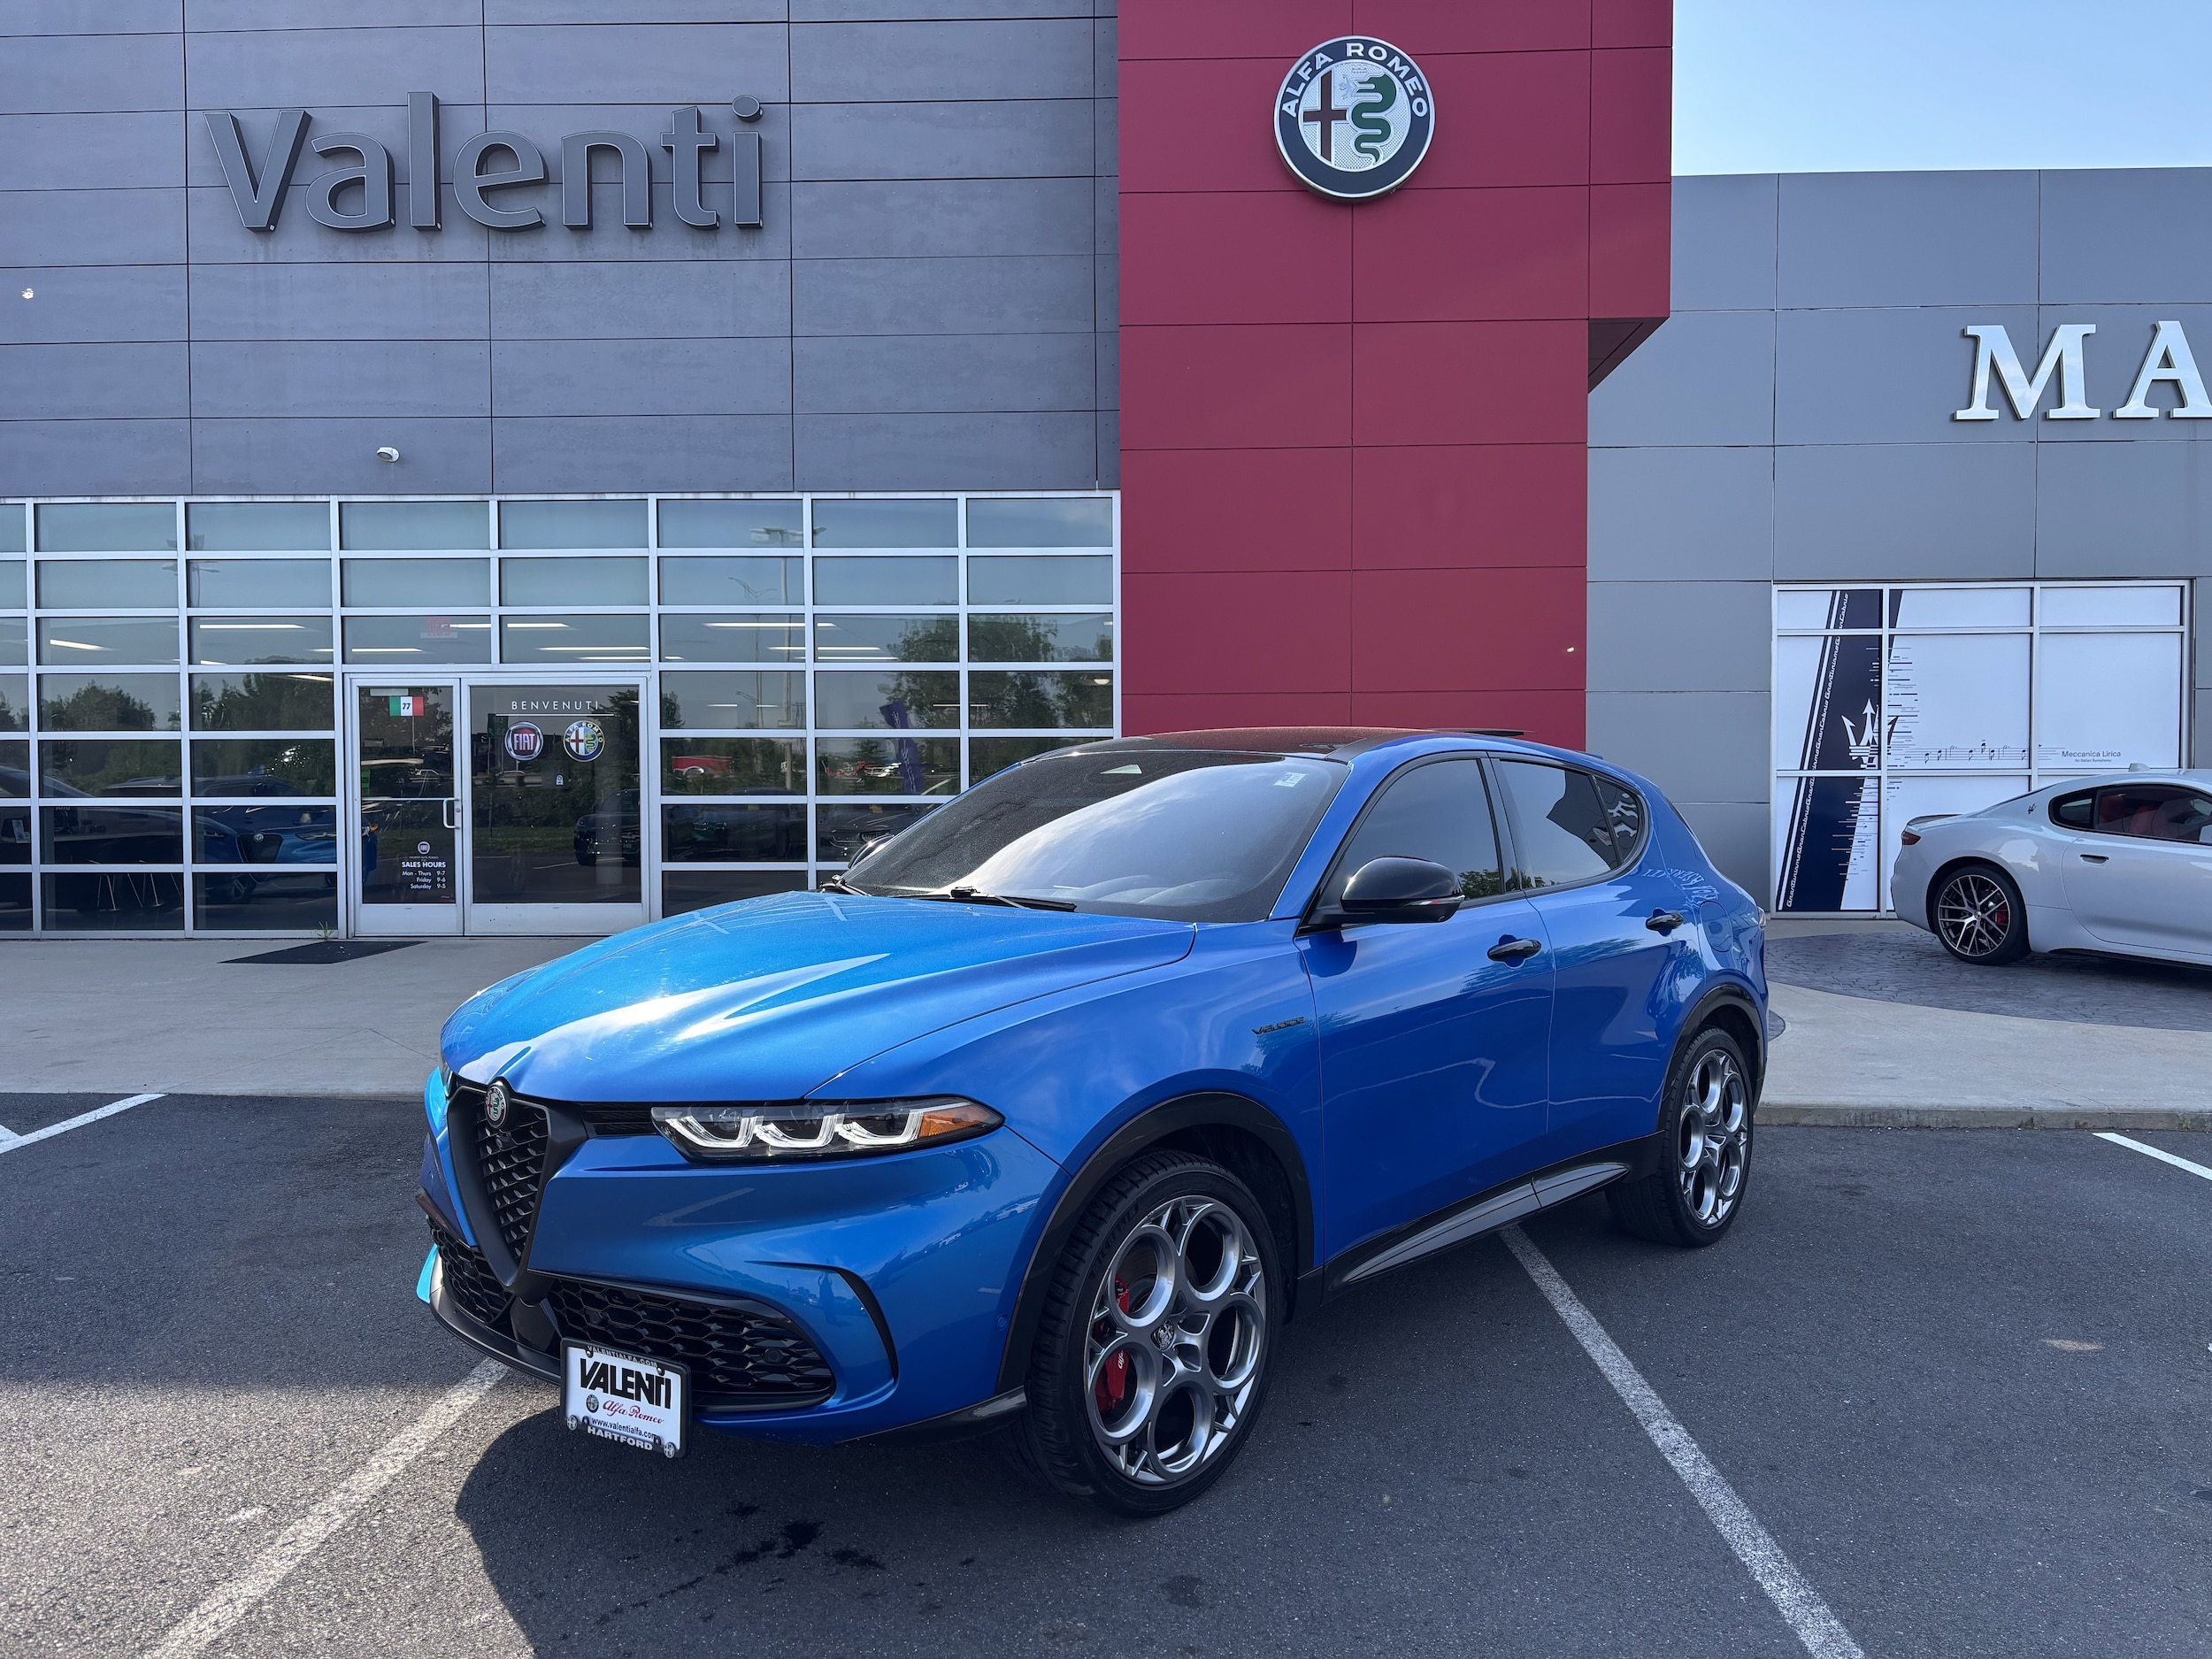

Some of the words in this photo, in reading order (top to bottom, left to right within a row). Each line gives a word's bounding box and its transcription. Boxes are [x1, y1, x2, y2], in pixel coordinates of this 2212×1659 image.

[1282, 52, 1333, 119] ALFA
[1346, 42, 1428, 118] ROMEO
[203, 91, 764, 234] Valenti
[511, 701, 598, 710] BENVENUTI
[513, 733, 536, 751] FIAT
[580, 1357, 672, 1410] VALENTI
[603, 1400, 628, 1417] Alfa
[628, 1405, 665, 1425] Romeo
[588, 1425, 653, 1451] HARTFORD
